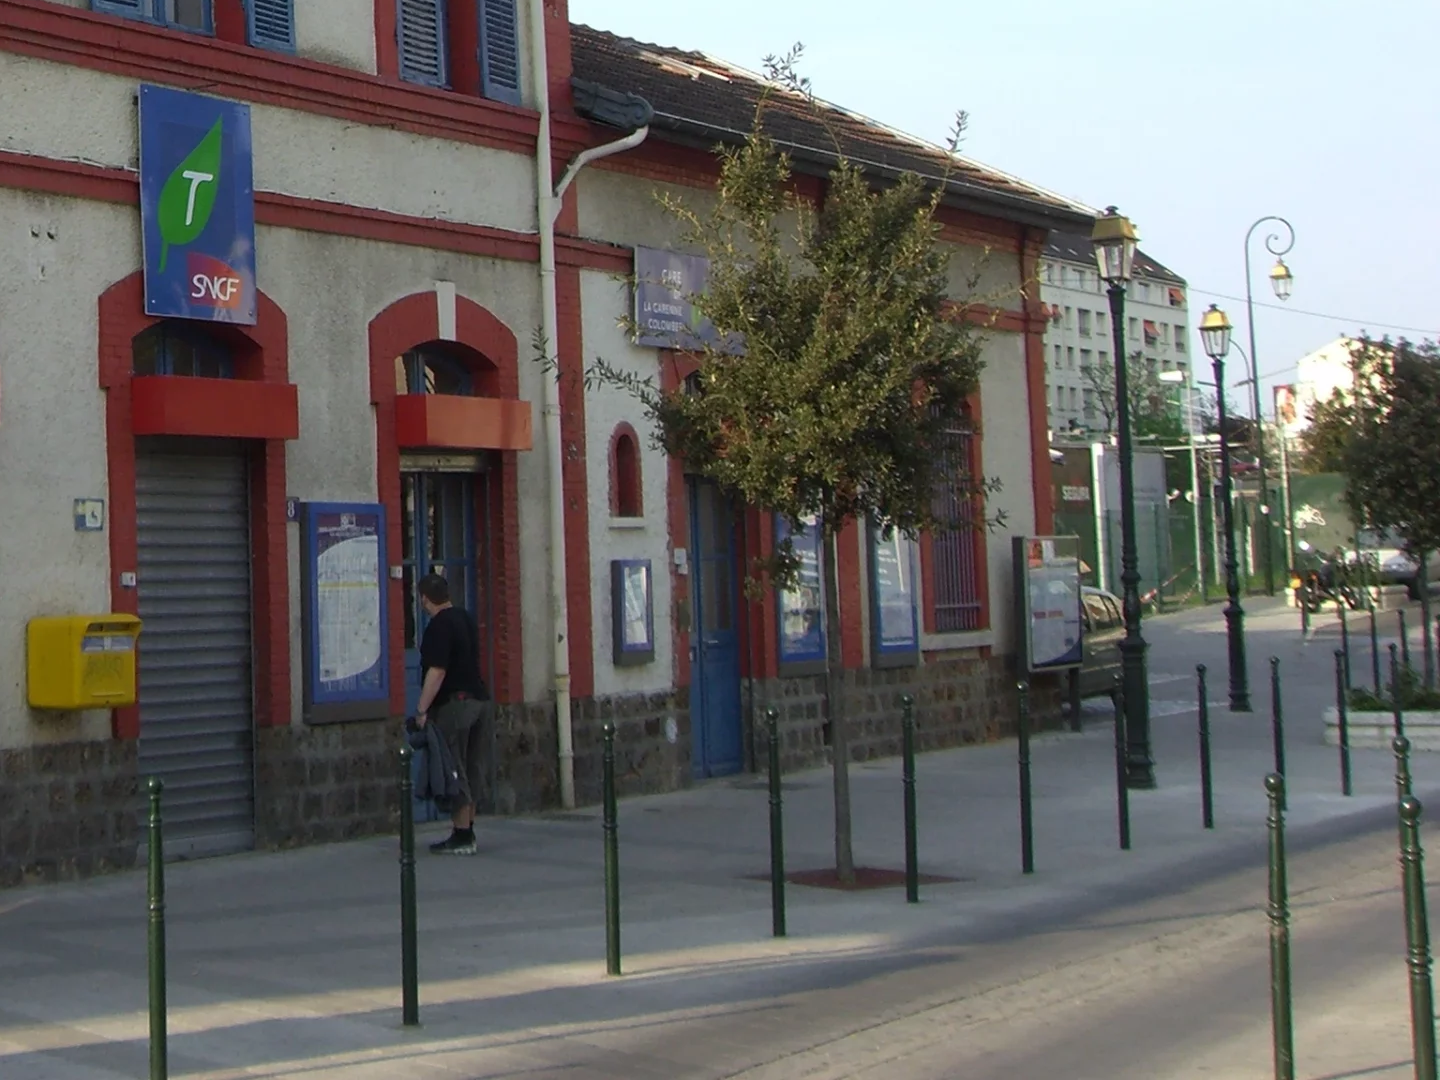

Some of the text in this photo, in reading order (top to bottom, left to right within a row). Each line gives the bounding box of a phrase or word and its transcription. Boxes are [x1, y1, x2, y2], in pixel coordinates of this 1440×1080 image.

[182, 170, 213, 226] T
[191, 273, 240, 302] SNCF
[643, 301, 683, 316] LA GARENNE
